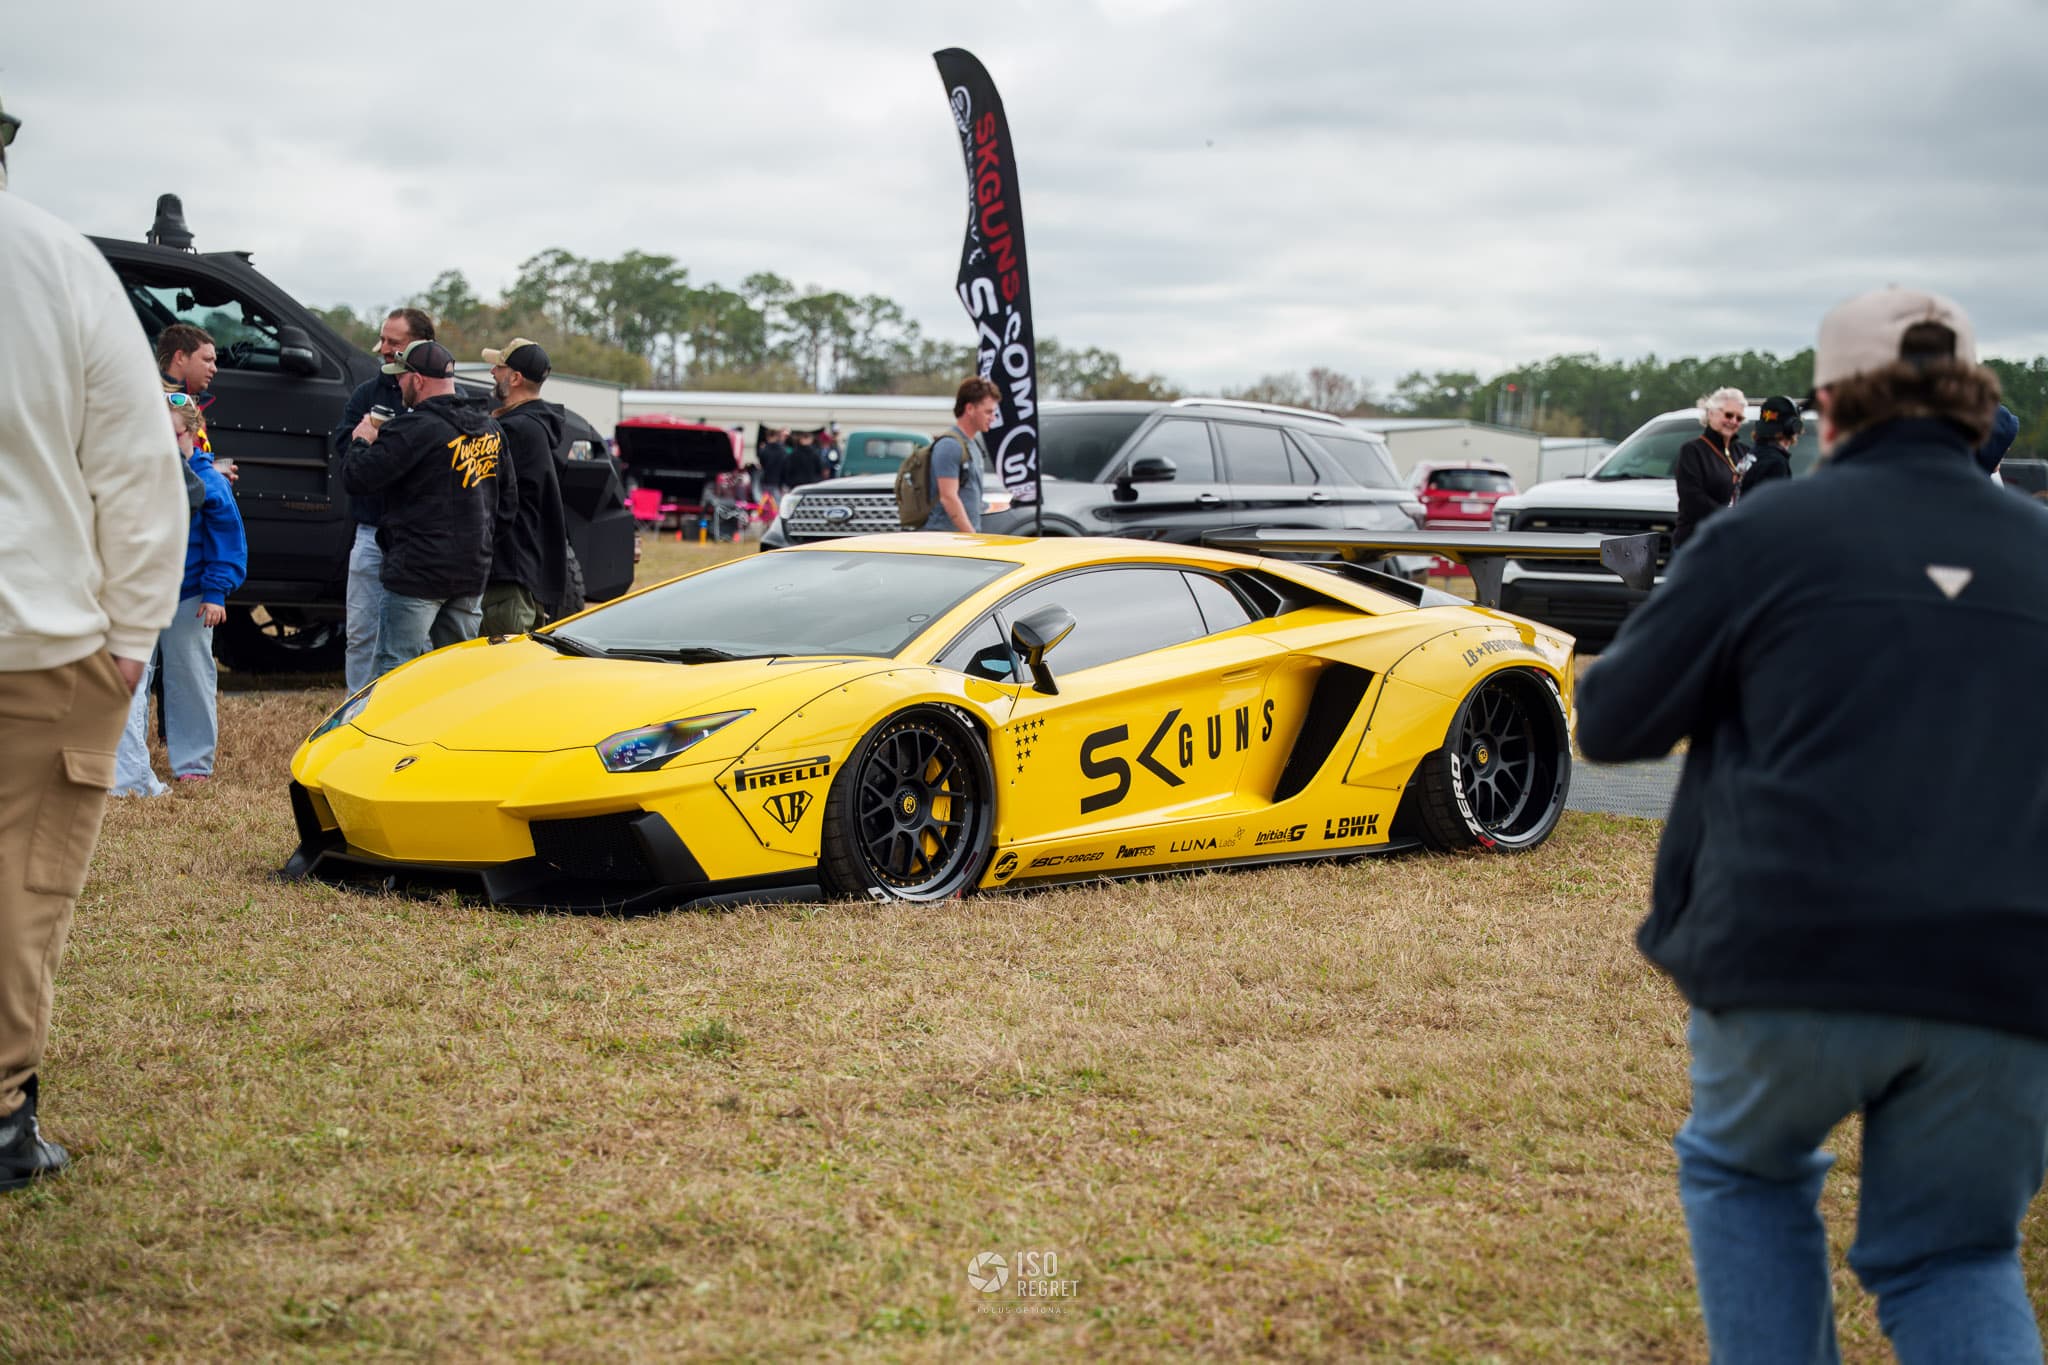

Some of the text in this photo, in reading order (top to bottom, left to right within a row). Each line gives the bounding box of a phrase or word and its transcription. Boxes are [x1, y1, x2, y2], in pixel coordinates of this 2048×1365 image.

[447, 431, 501, 469] Twisted
[734, 755, 831, 792] PIRELLI
[1450, 752, 1484, 836] ZERO
[1324, 814, 1379, 840] LBWK
[1064, 852, 1105, 865] FORGED
[1170, 837, 1217, 853] LUNA
